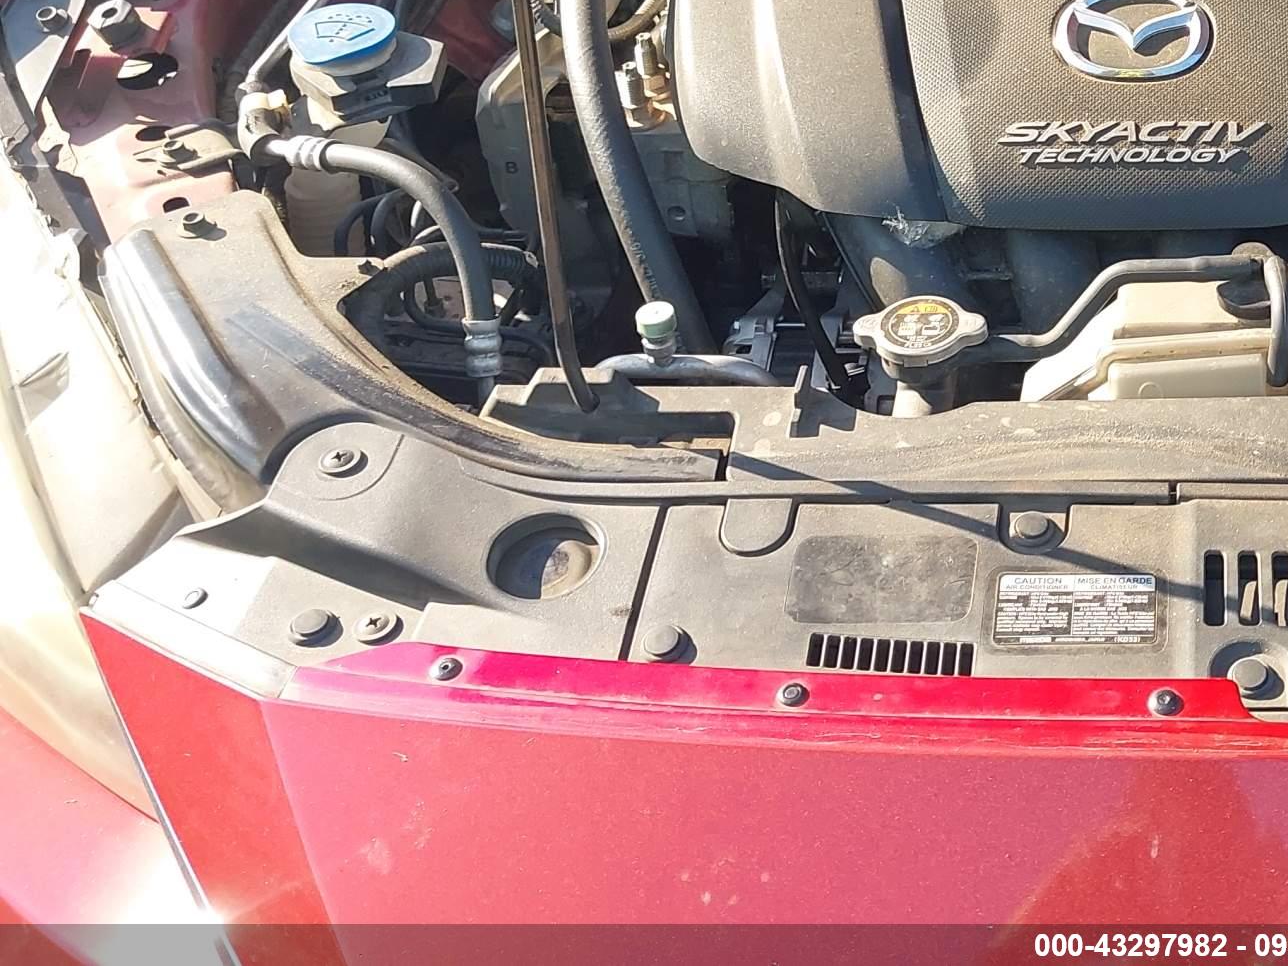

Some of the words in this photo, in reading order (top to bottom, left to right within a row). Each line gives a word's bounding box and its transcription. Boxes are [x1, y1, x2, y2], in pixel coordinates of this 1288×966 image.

[998, 120, 1267, 144] SKYACTIV
[1018, 148, 1242, 164] TECHNOLOGY
[1014, 577, 1062, 585] CAUTION
[1077, 577, 1101, 585] MISE
[1103, 577, 1117, 585] EN
[1118, 577, 1153, 585] GARDE
